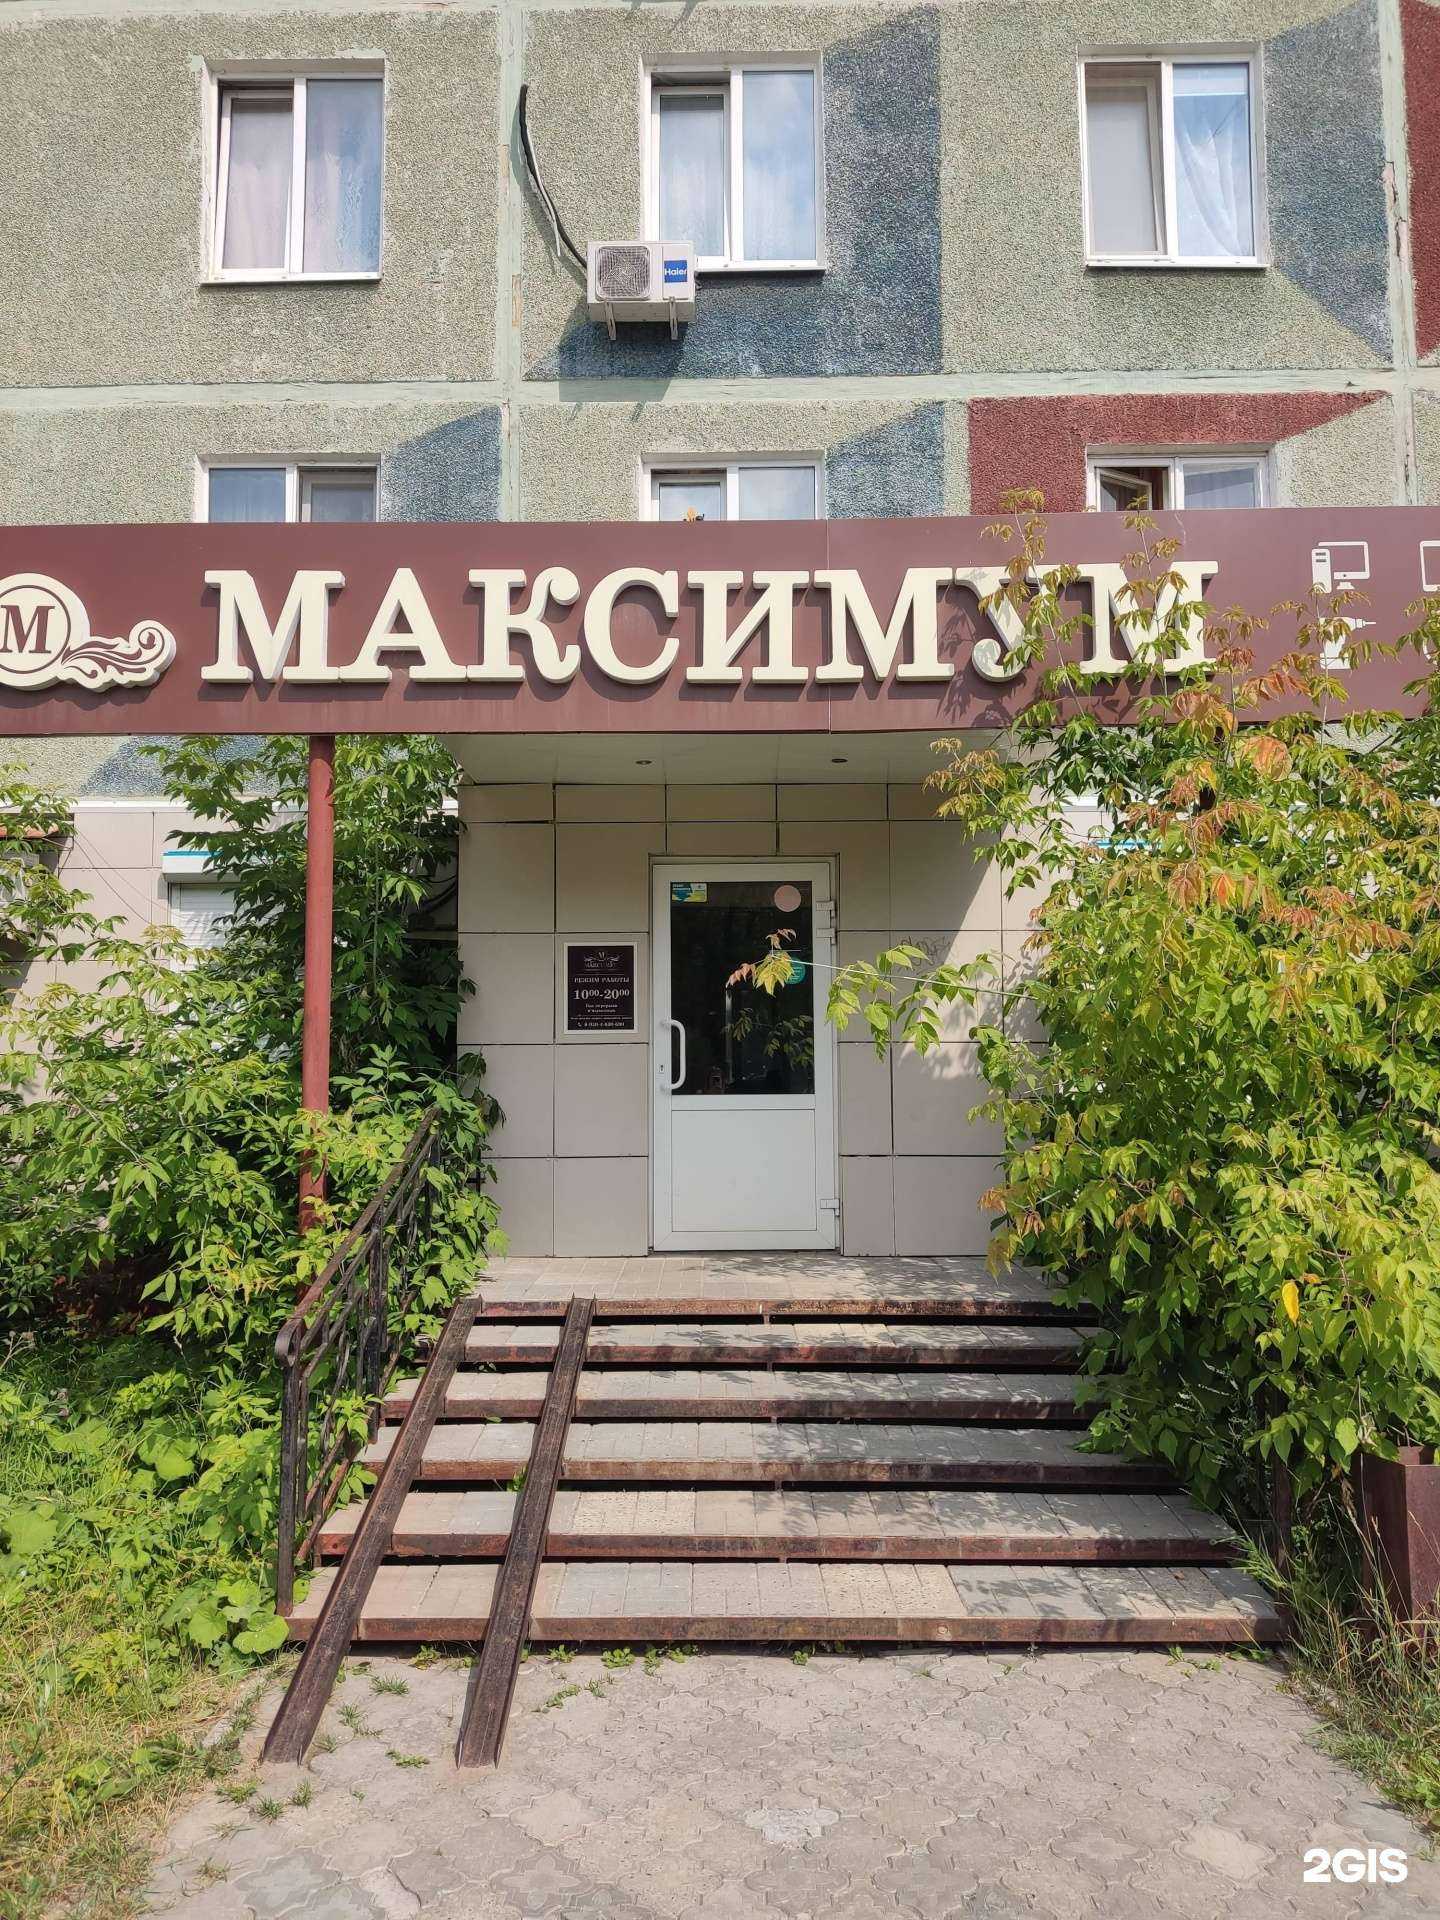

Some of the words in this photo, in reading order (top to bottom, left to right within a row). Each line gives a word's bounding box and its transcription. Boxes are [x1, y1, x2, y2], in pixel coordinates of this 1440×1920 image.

[664, 268, 687, 276] Haier
[0, 605, 55, 654] М
[201, 561, 1219, 684] МАКСИМУМ
